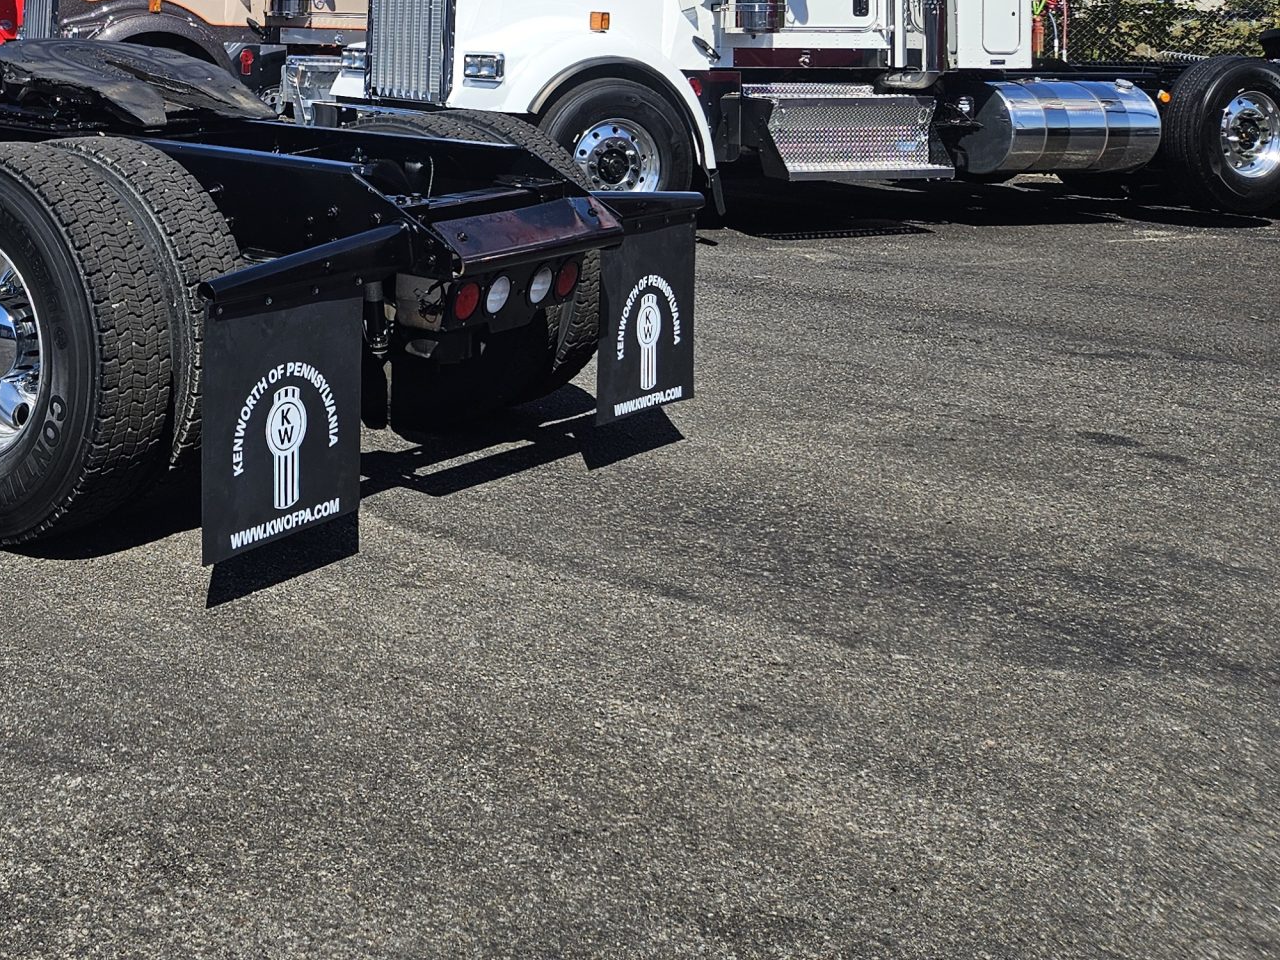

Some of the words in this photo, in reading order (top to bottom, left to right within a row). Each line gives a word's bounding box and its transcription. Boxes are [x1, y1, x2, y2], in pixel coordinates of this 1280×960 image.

[617, 287, 640, 361] KENWORTH
[638, 275, 648, 291] OF
[648, 274, 681, 346] PENNSYLVANIA
[232, 377, 269, 477] KENWORTH
[268, 363, 285, 384] OF
[286, 361, 339, 448] PENNSYLVANIA
[614, 386, 682, 417] WWW.KWOFPA.COM
[230, 497, 340, 550] WWW.KWOFPA.COM
